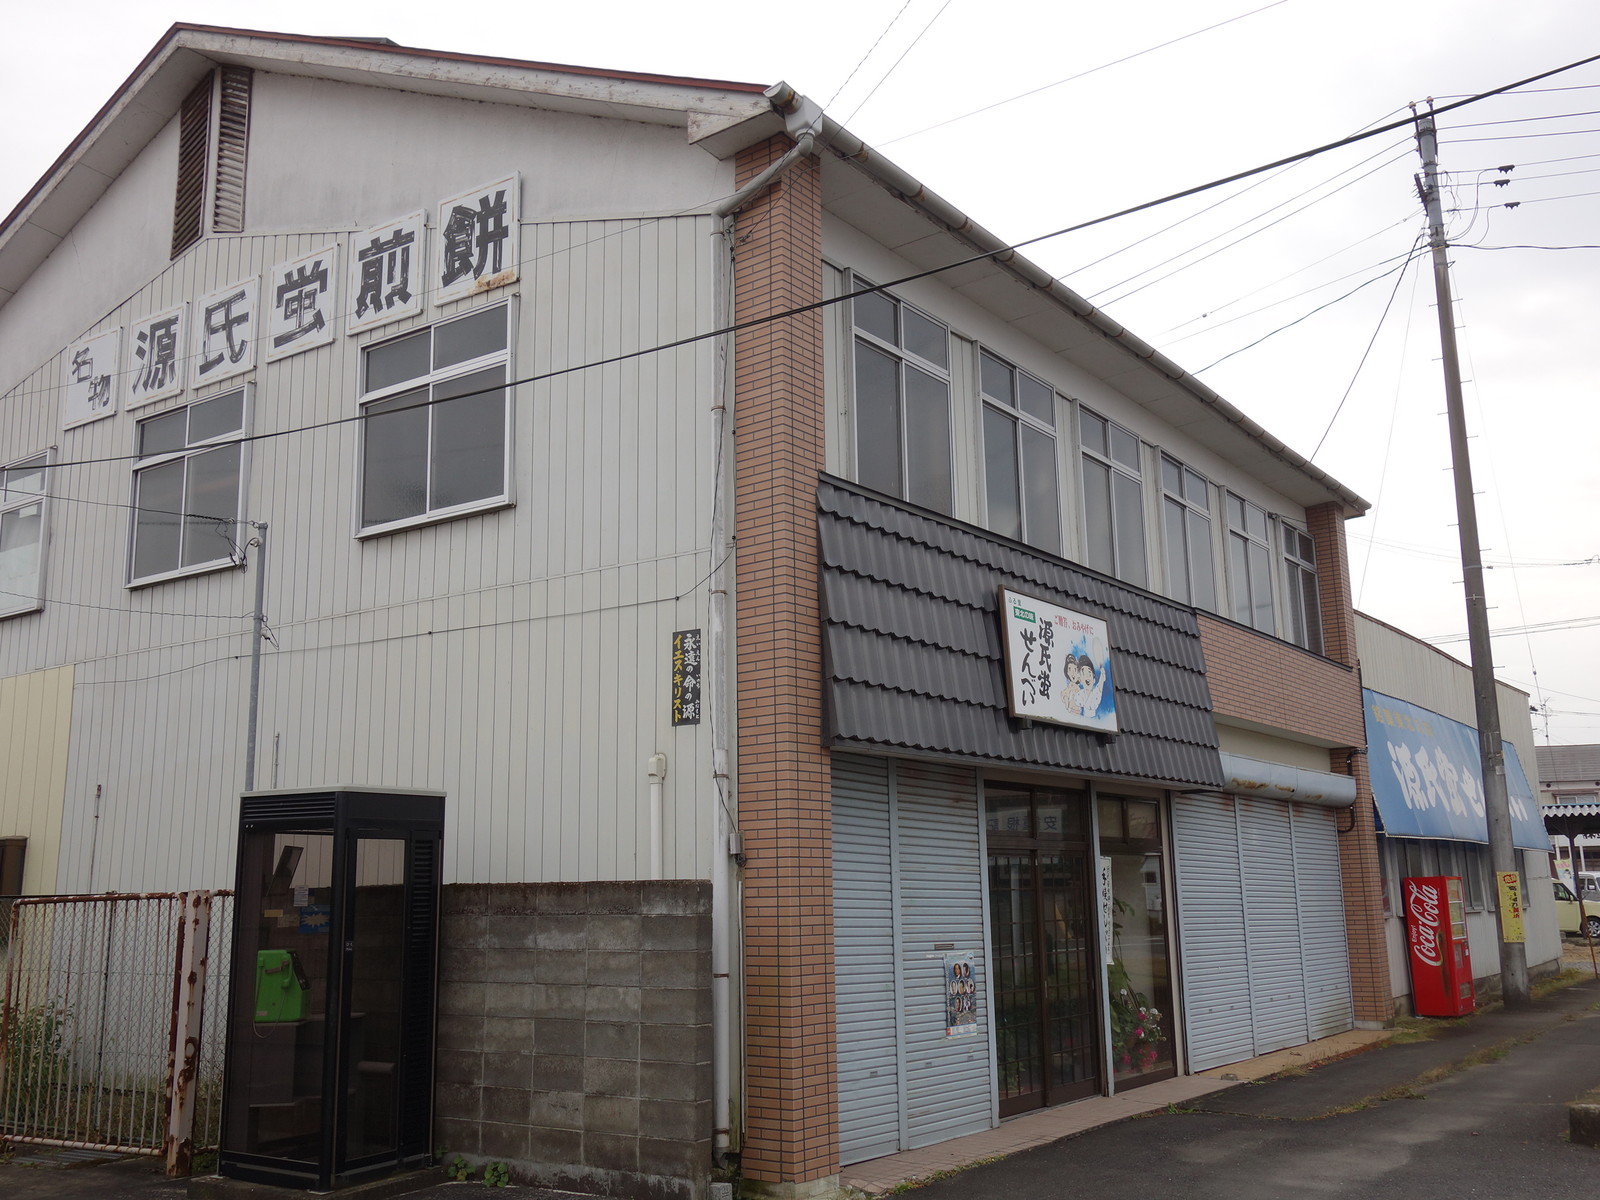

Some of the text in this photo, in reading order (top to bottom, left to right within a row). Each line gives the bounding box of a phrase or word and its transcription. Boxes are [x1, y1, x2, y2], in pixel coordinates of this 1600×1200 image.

[132, 189, 510, 394] 源氏堂煎餅
[71, 346, 111, 411] 名物
[672, 634, 685, 723] イエス・キリスト
[682, 633, 698, 720] 永遠の命の源
[1019, 628, 1037, 707] せんべい
[1038, 617, 1055, 700] 源氏堂
[1387, 740, 1529, 823] 源氏堂せい
[1409, 879, 1443, 967] Coca-Cola
